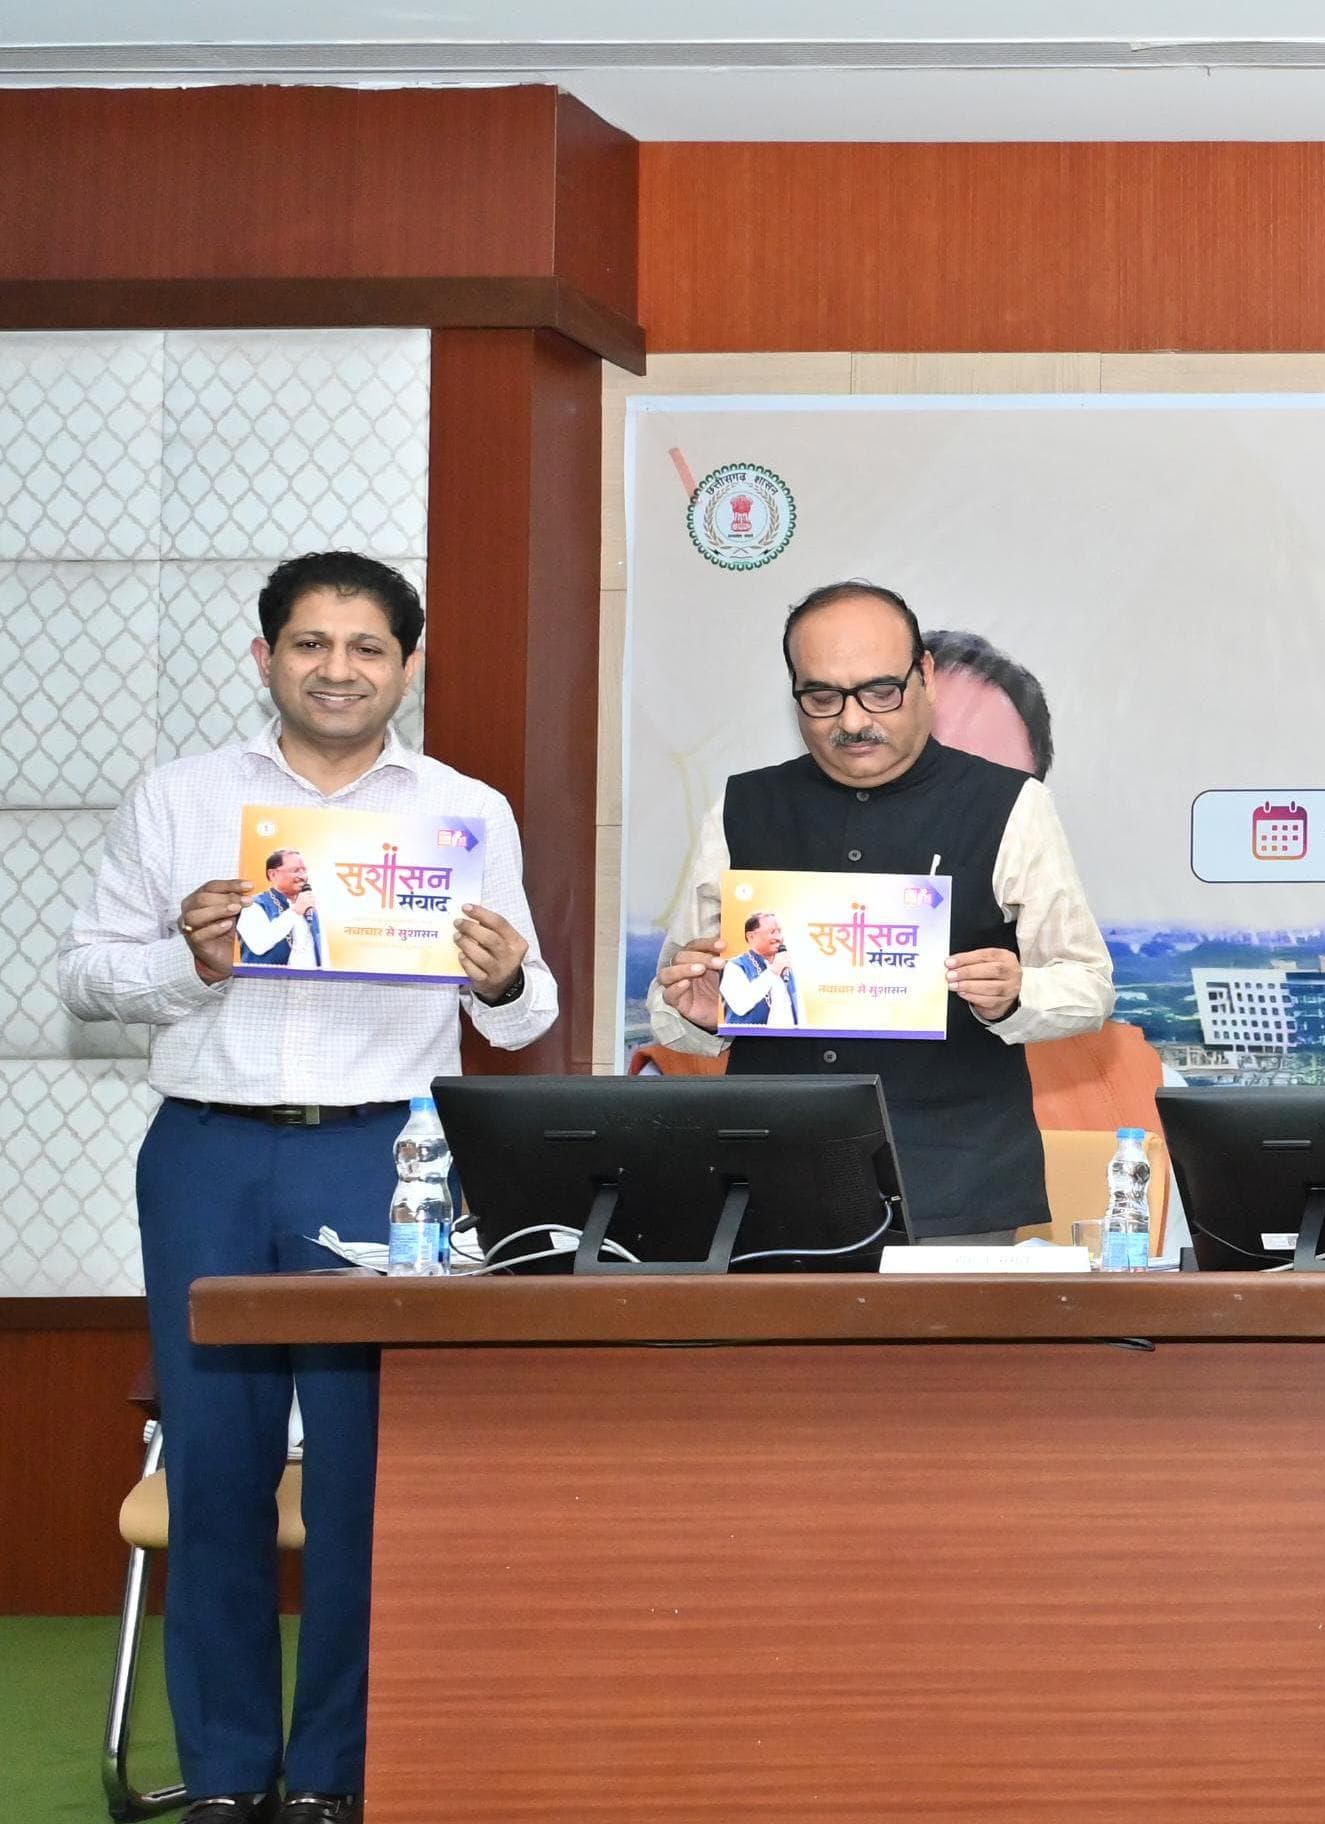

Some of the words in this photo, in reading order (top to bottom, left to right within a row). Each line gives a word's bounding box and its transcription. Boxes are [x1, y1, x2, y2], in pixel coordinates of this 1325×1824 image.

[754, 475, 779, 496] शासन
[334, 842, 453, 910] सुशासन
[396, 891, 452, 913] संवाद
[398, 928, 439, 941] सुशासन
[808, 902, 920, 968] सुशासन
[866, 949, 920, 969] संवाद
